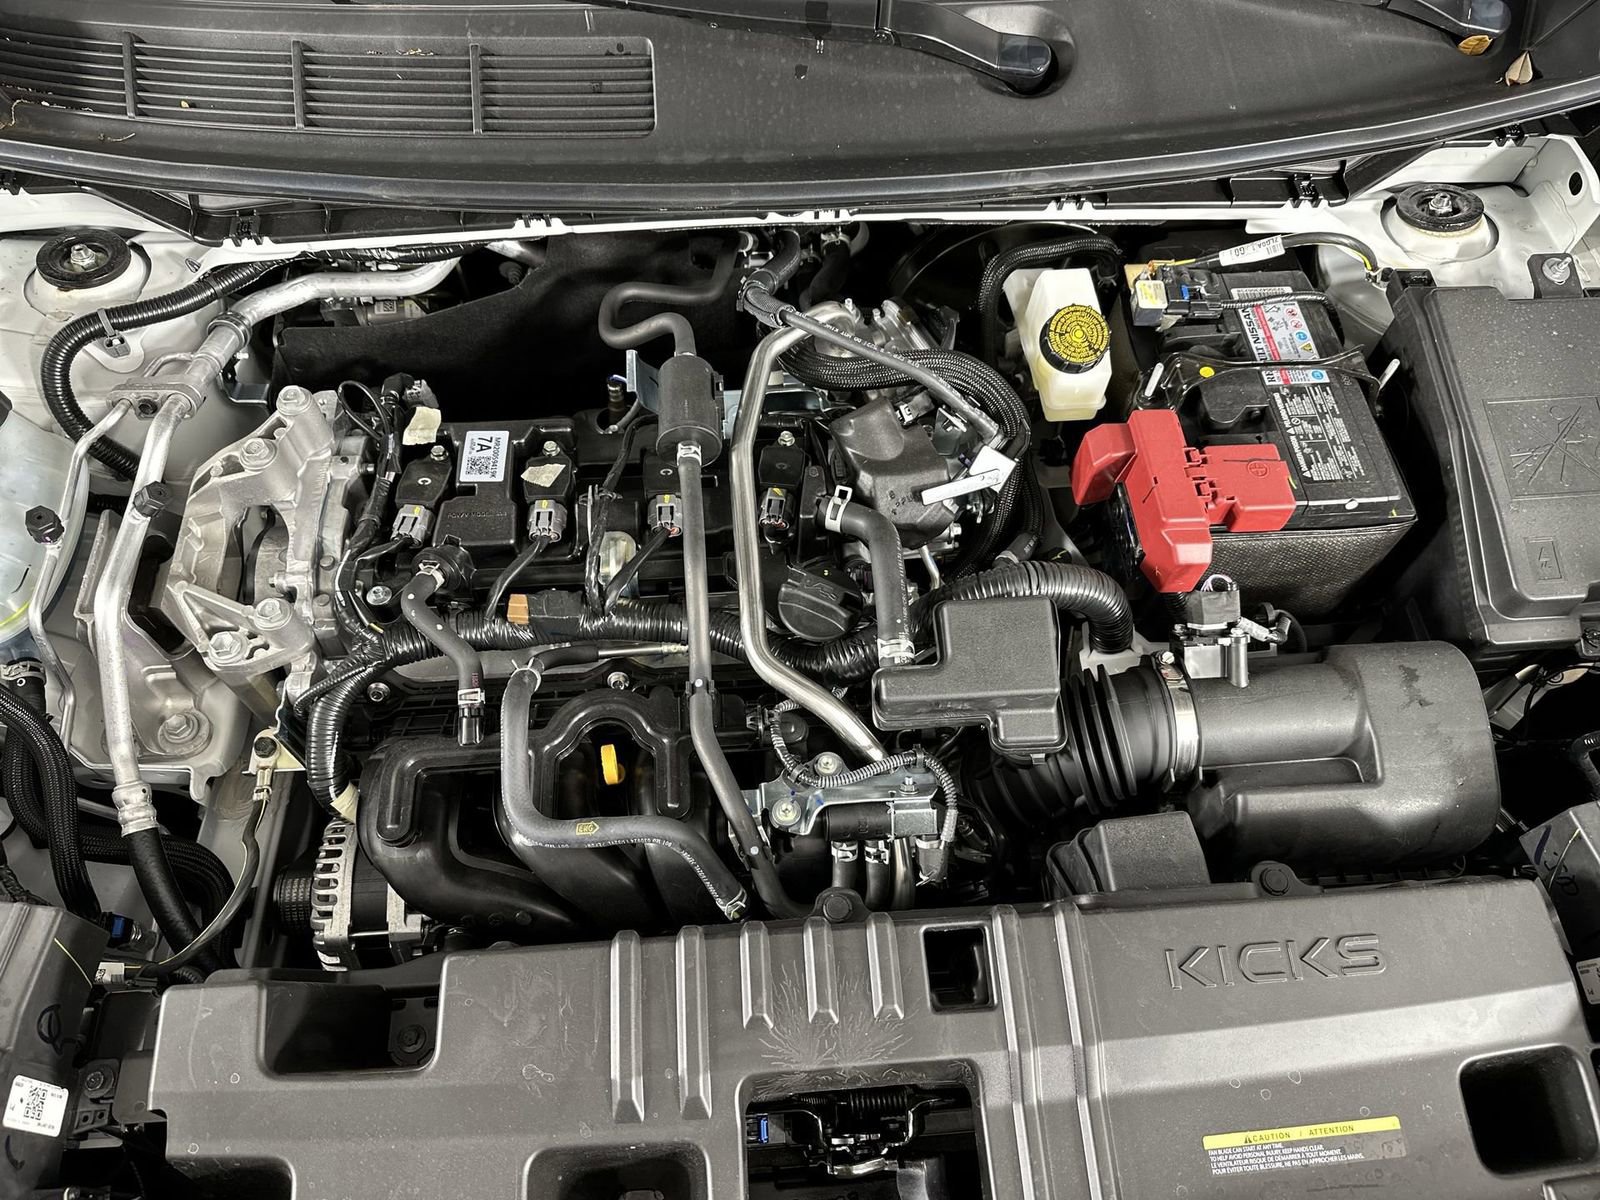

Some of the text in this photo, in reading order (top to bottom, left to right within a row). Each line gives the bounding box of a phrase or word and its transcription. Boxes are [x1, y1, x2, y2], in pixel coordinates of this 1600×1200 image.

[476, 436, 493, 453] 7A
[1165, 934, 1386, 990] KICKS
[1252, 1132, 1291, 1142] CAUTION
[1309, 1126, 1354, 1136] ATTENTION
[1218, 1159, 1248, 1168] VENTILATEUR
[1310, 1156, 1337, 1164] APPROCHER
